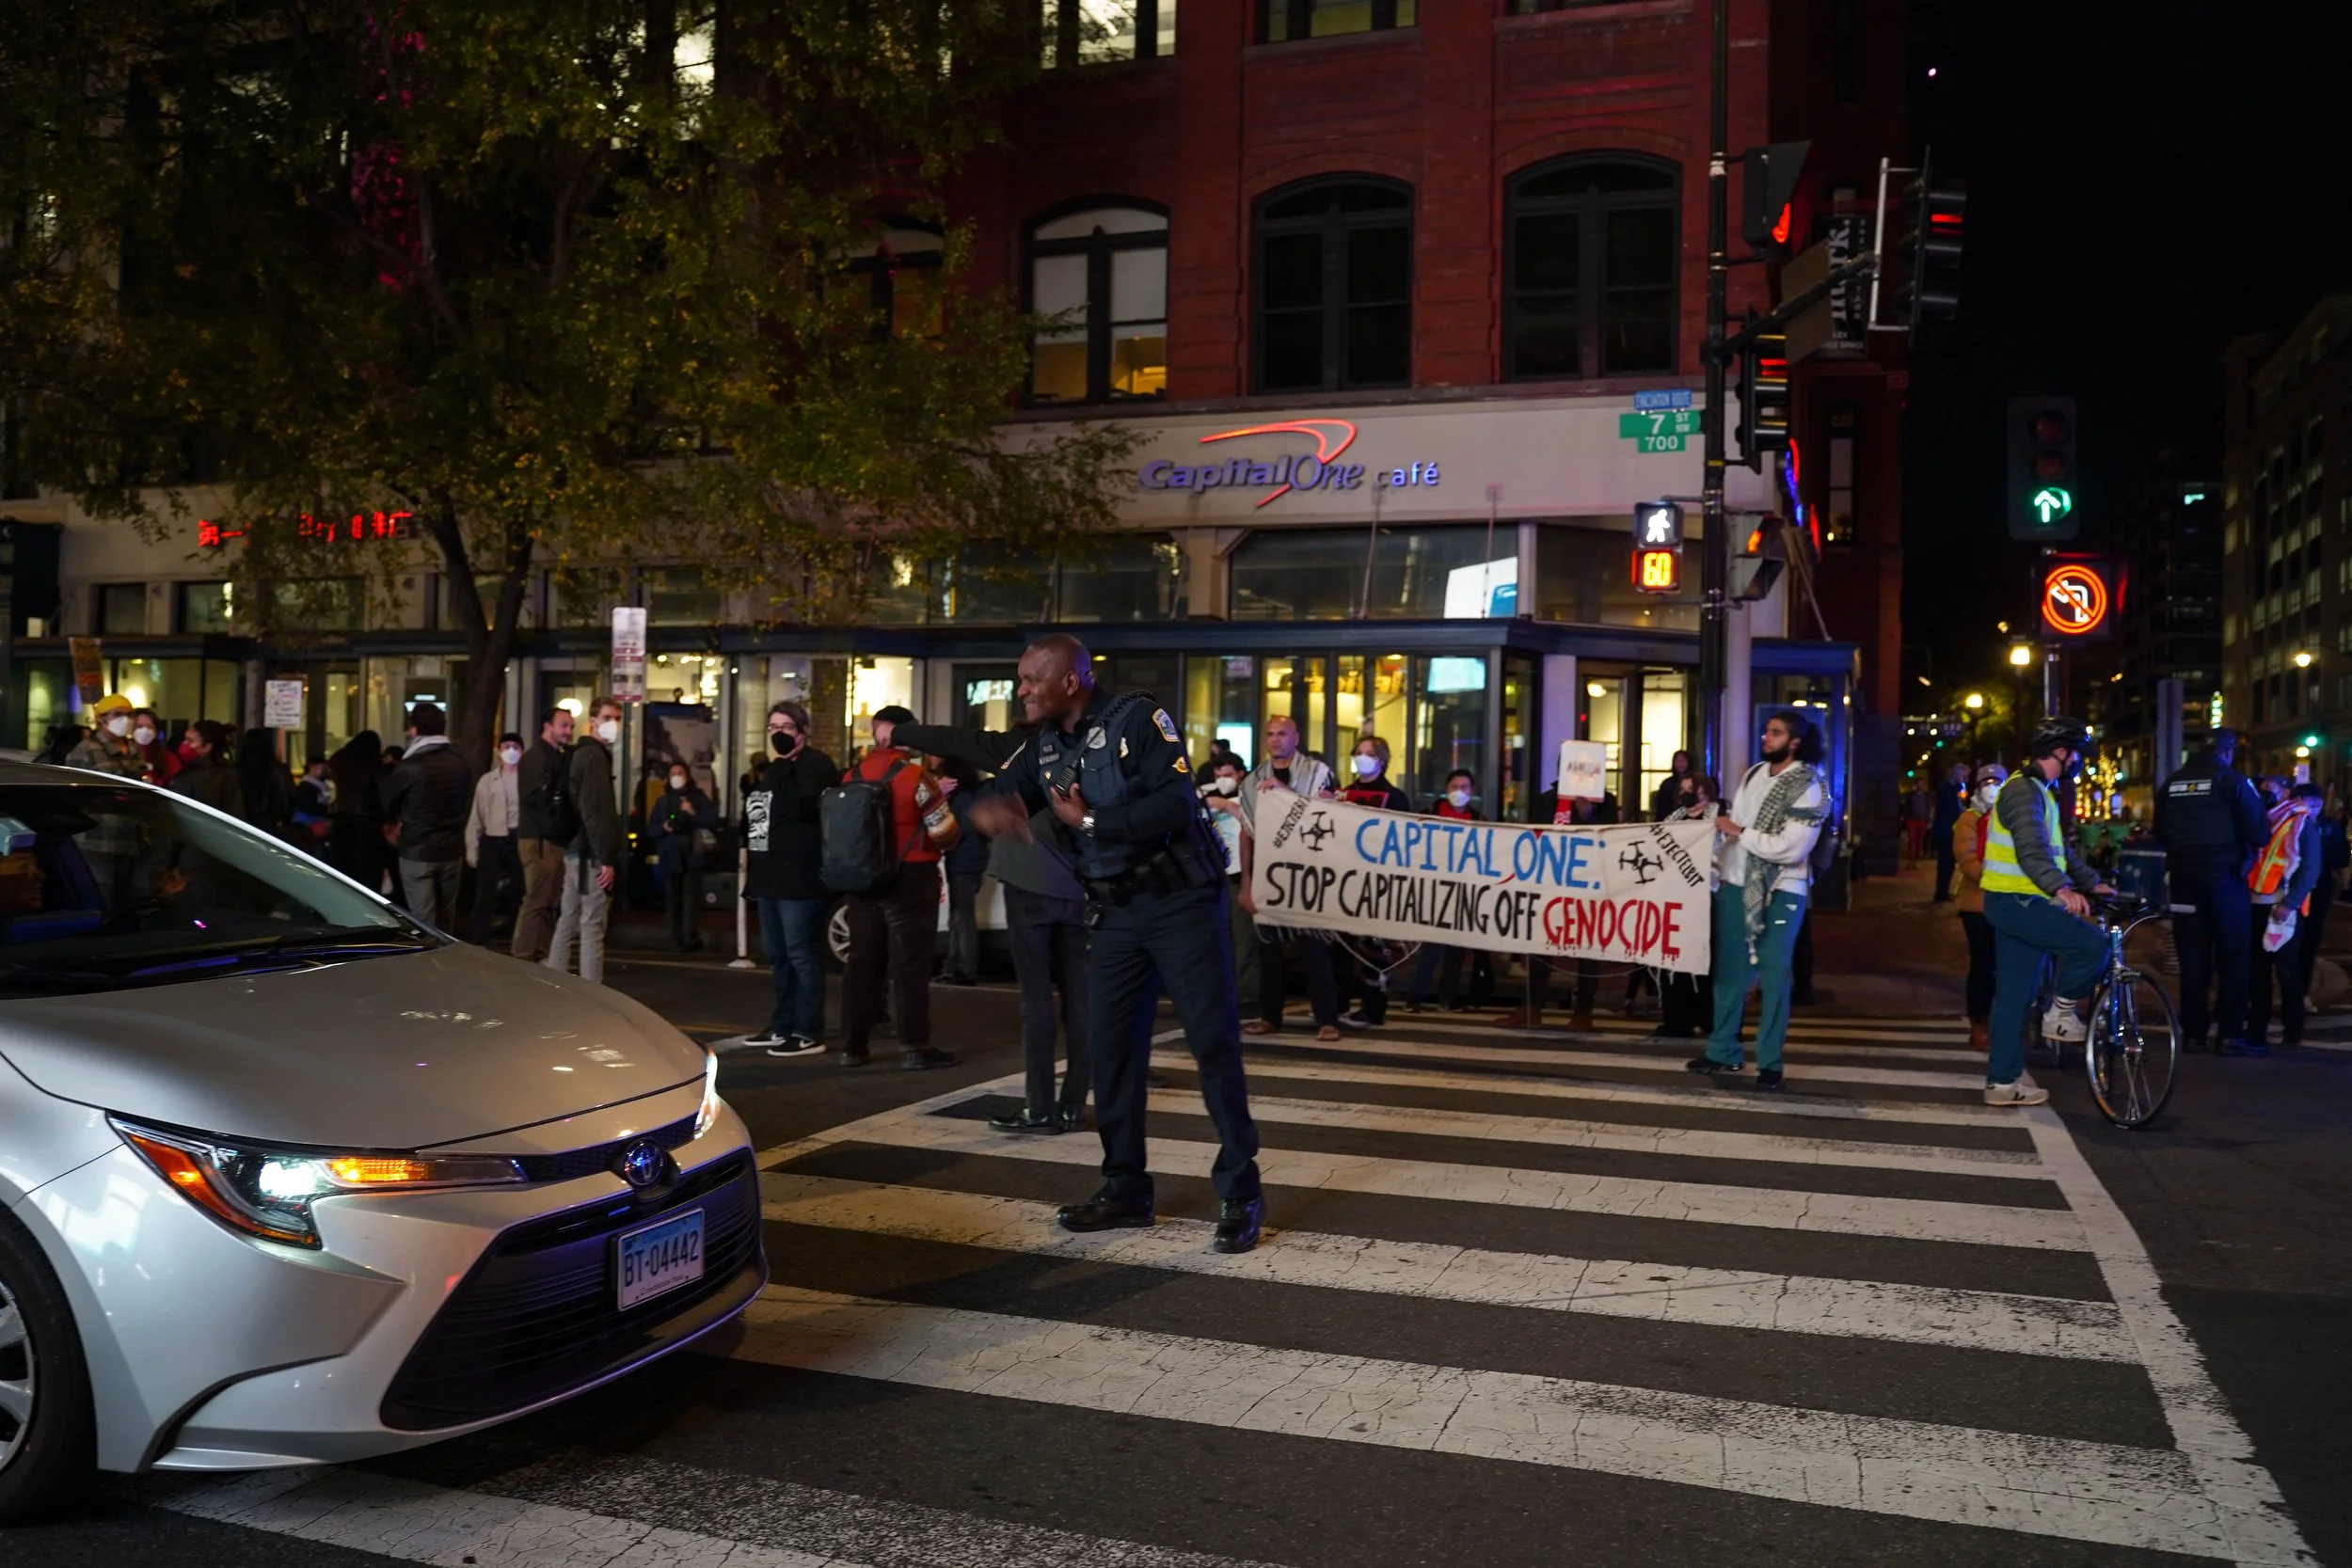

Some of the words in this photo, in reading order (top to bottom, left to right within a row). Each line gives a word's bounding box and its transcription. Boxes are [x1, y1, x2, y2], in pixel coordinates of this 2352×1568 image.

[1648, 414, 1665, 435] 7
[1676, 412, 1690, 422] ST
[1676, 423, 1691, 433] NW
[1645, 436, 1678, 451] 700
[1373, 461, 1440, 489] café
[1643, 552, 1672, 587] 60
[1355, 818, 1502, 878] CAPITAL
[1513, 830, 1606, 890] ONE:
[1265, 862, 1336, 913] STOP
[1339, 869, 1491, 934] CAPITALIZING
[1494, 890, 1541, 941] OFF
[1543, 896, 1683, 959] GENOCIDE
